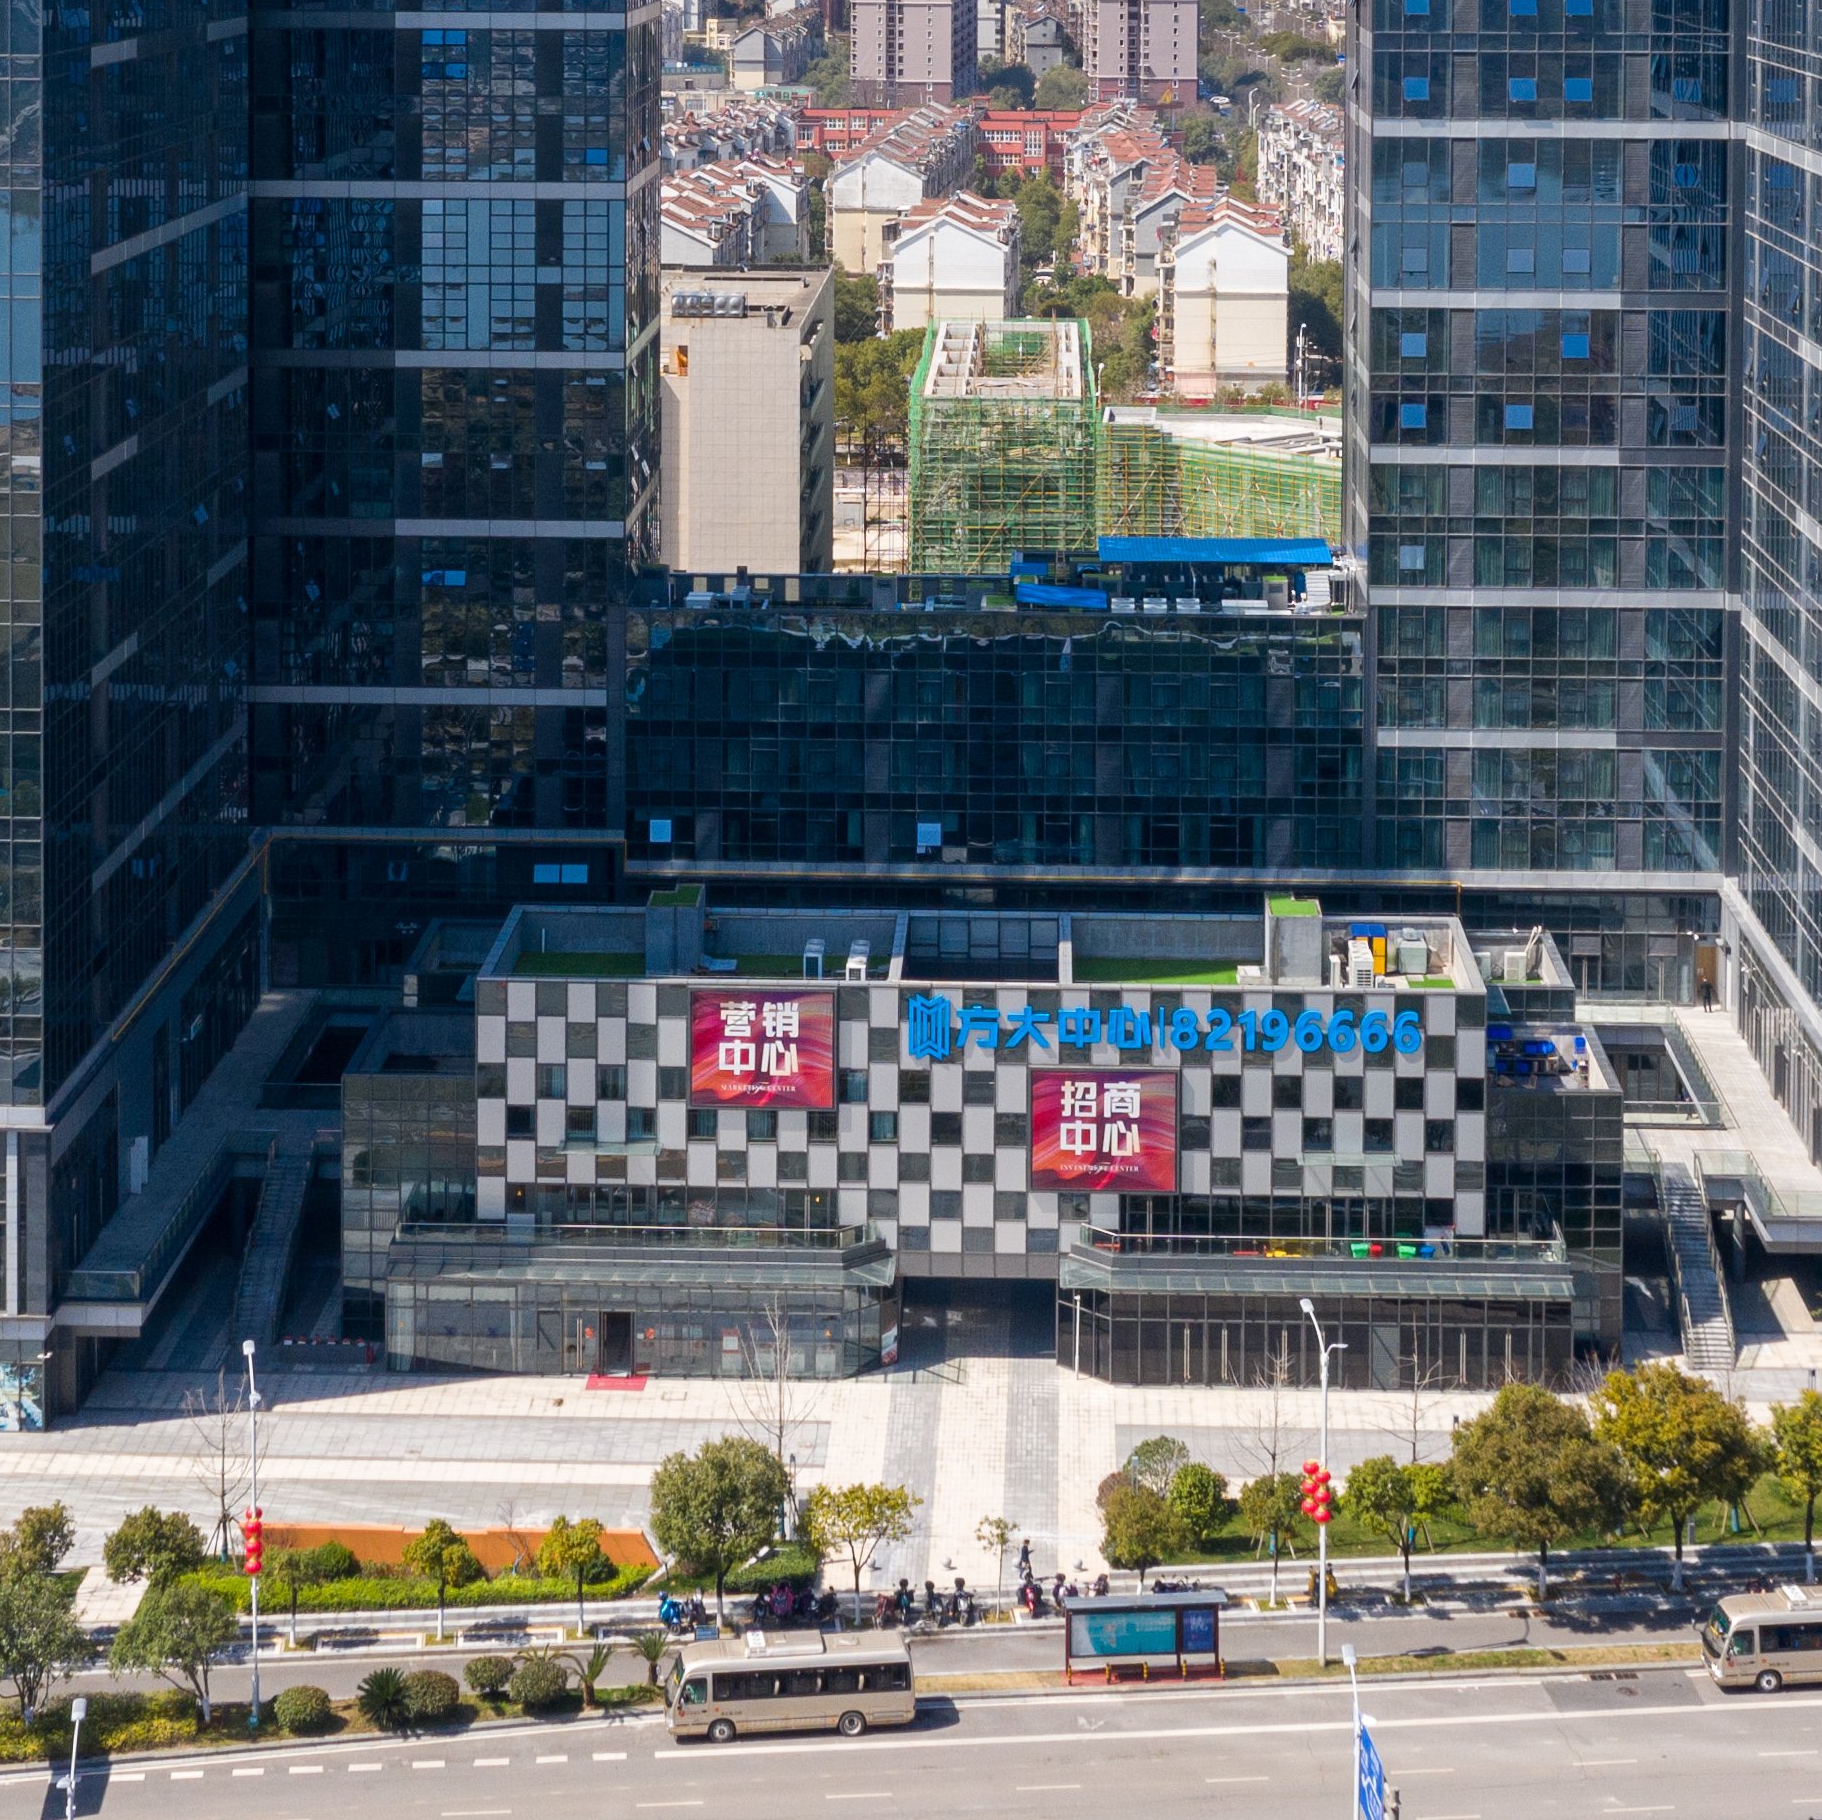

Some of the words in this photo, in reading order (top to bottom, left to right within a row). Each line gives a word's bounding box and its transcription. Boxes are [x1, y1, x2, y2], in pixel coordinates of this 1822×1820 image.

[719, 1000, 800, 1038] 营销
[956, 1004, 1152, 1050] 方大中心
[1171, 1006, 1423, 1053] 82196666
[718, 1039, 799, 1076] 中心
[1060, 1080, 1142, 1118] 招商
[1060, 1119, 1141, 1156] 中心
